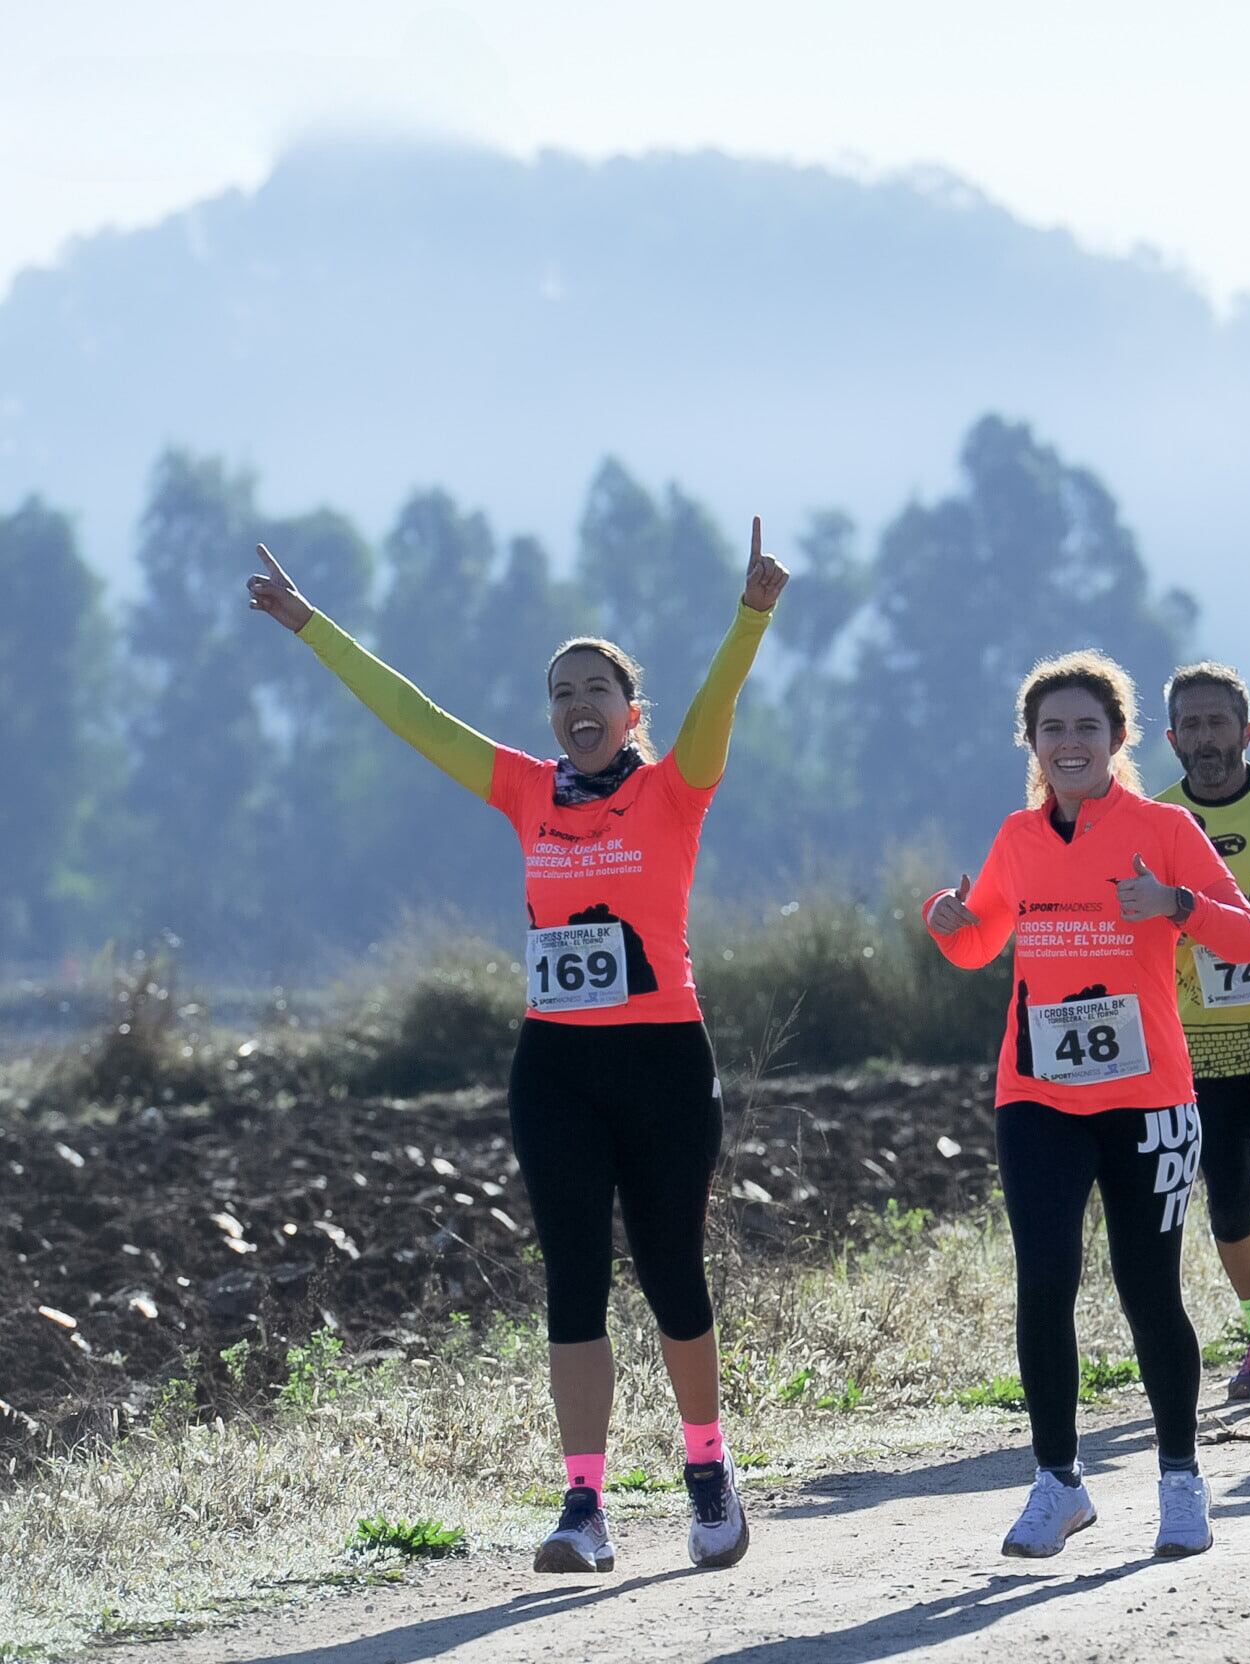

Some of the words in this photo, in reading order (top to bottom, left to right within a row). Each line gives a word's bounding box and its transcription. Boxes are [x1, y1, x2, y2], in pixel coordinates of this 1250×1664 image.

[536, 843, 568, 855] CROSS
[607, 838, 623, 850] 8K
[582, 856, 596, 867] EL
[599, 850, 642, 865] TORNO
[595, 865, 642, 876] naturaleza
[1029, 903, 1103, 912] SPORTMADNESS
[540, 931, 562, 943] CROSS
[563, 929, 595, 940] RURAL
[597, 927, 611, 937] 8K
[1020, 921, 1054, 932] CROSS
[1056, 921, 1097, 932] RURAL
[1099, 921, 1116, 932] 8K
[1074, 934, 1089, 945] EL
[1091, 934, 1134, 945] TORNO
[536, 950, 617, 993] 169
[1044, 1007, 1075, 1019] CROSS
[1076, 1003, 1109, 1015] RURAL
[1111, 999, 1126, 1009] 8K
[1088, 1012, 1096, 1020] EL
[1097, 1010, 1119, 1019] TORNO
[1056, 1025, 1120, 1066] 48
[1153, 1140, 1199, 1193] DO
[1160, 1183, 1191, 1233] IT
